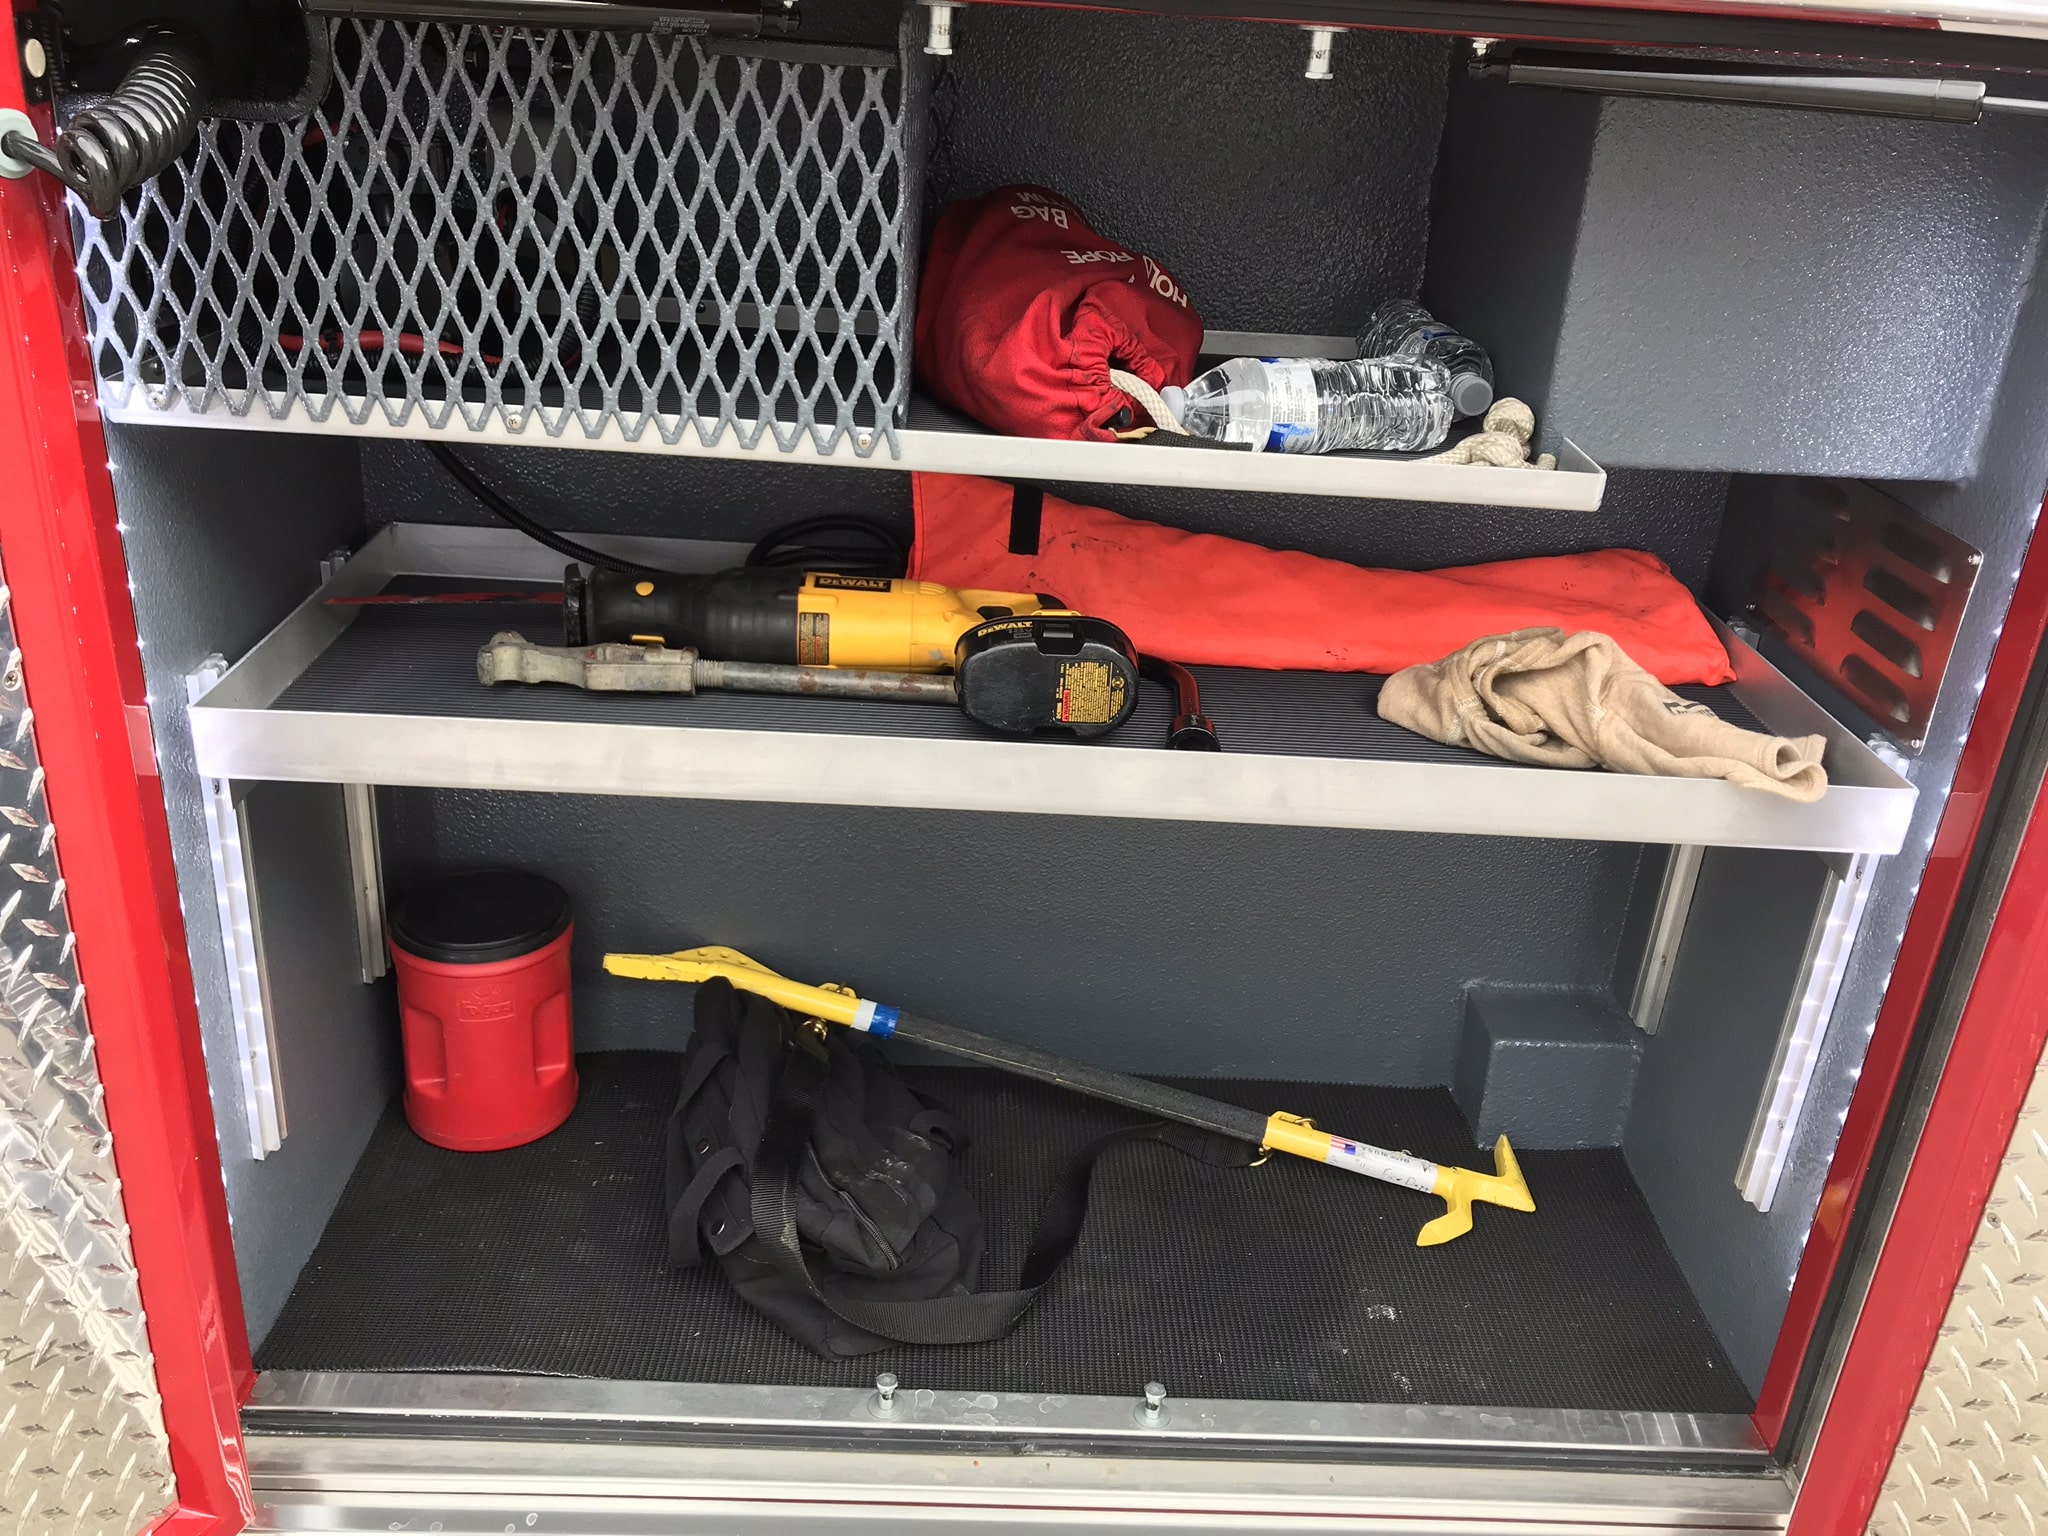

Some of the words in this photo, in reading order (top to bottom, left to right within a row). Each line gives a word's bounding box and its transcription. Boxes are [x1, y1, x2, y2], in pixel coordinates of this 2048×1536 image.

[1010, 205, 1069, 230] BAG
[1060, 250, 1135, 265] ROPE
[819, 577, 887, 588] DEWALT
[978, 621, 1033, 638] DEWALT
